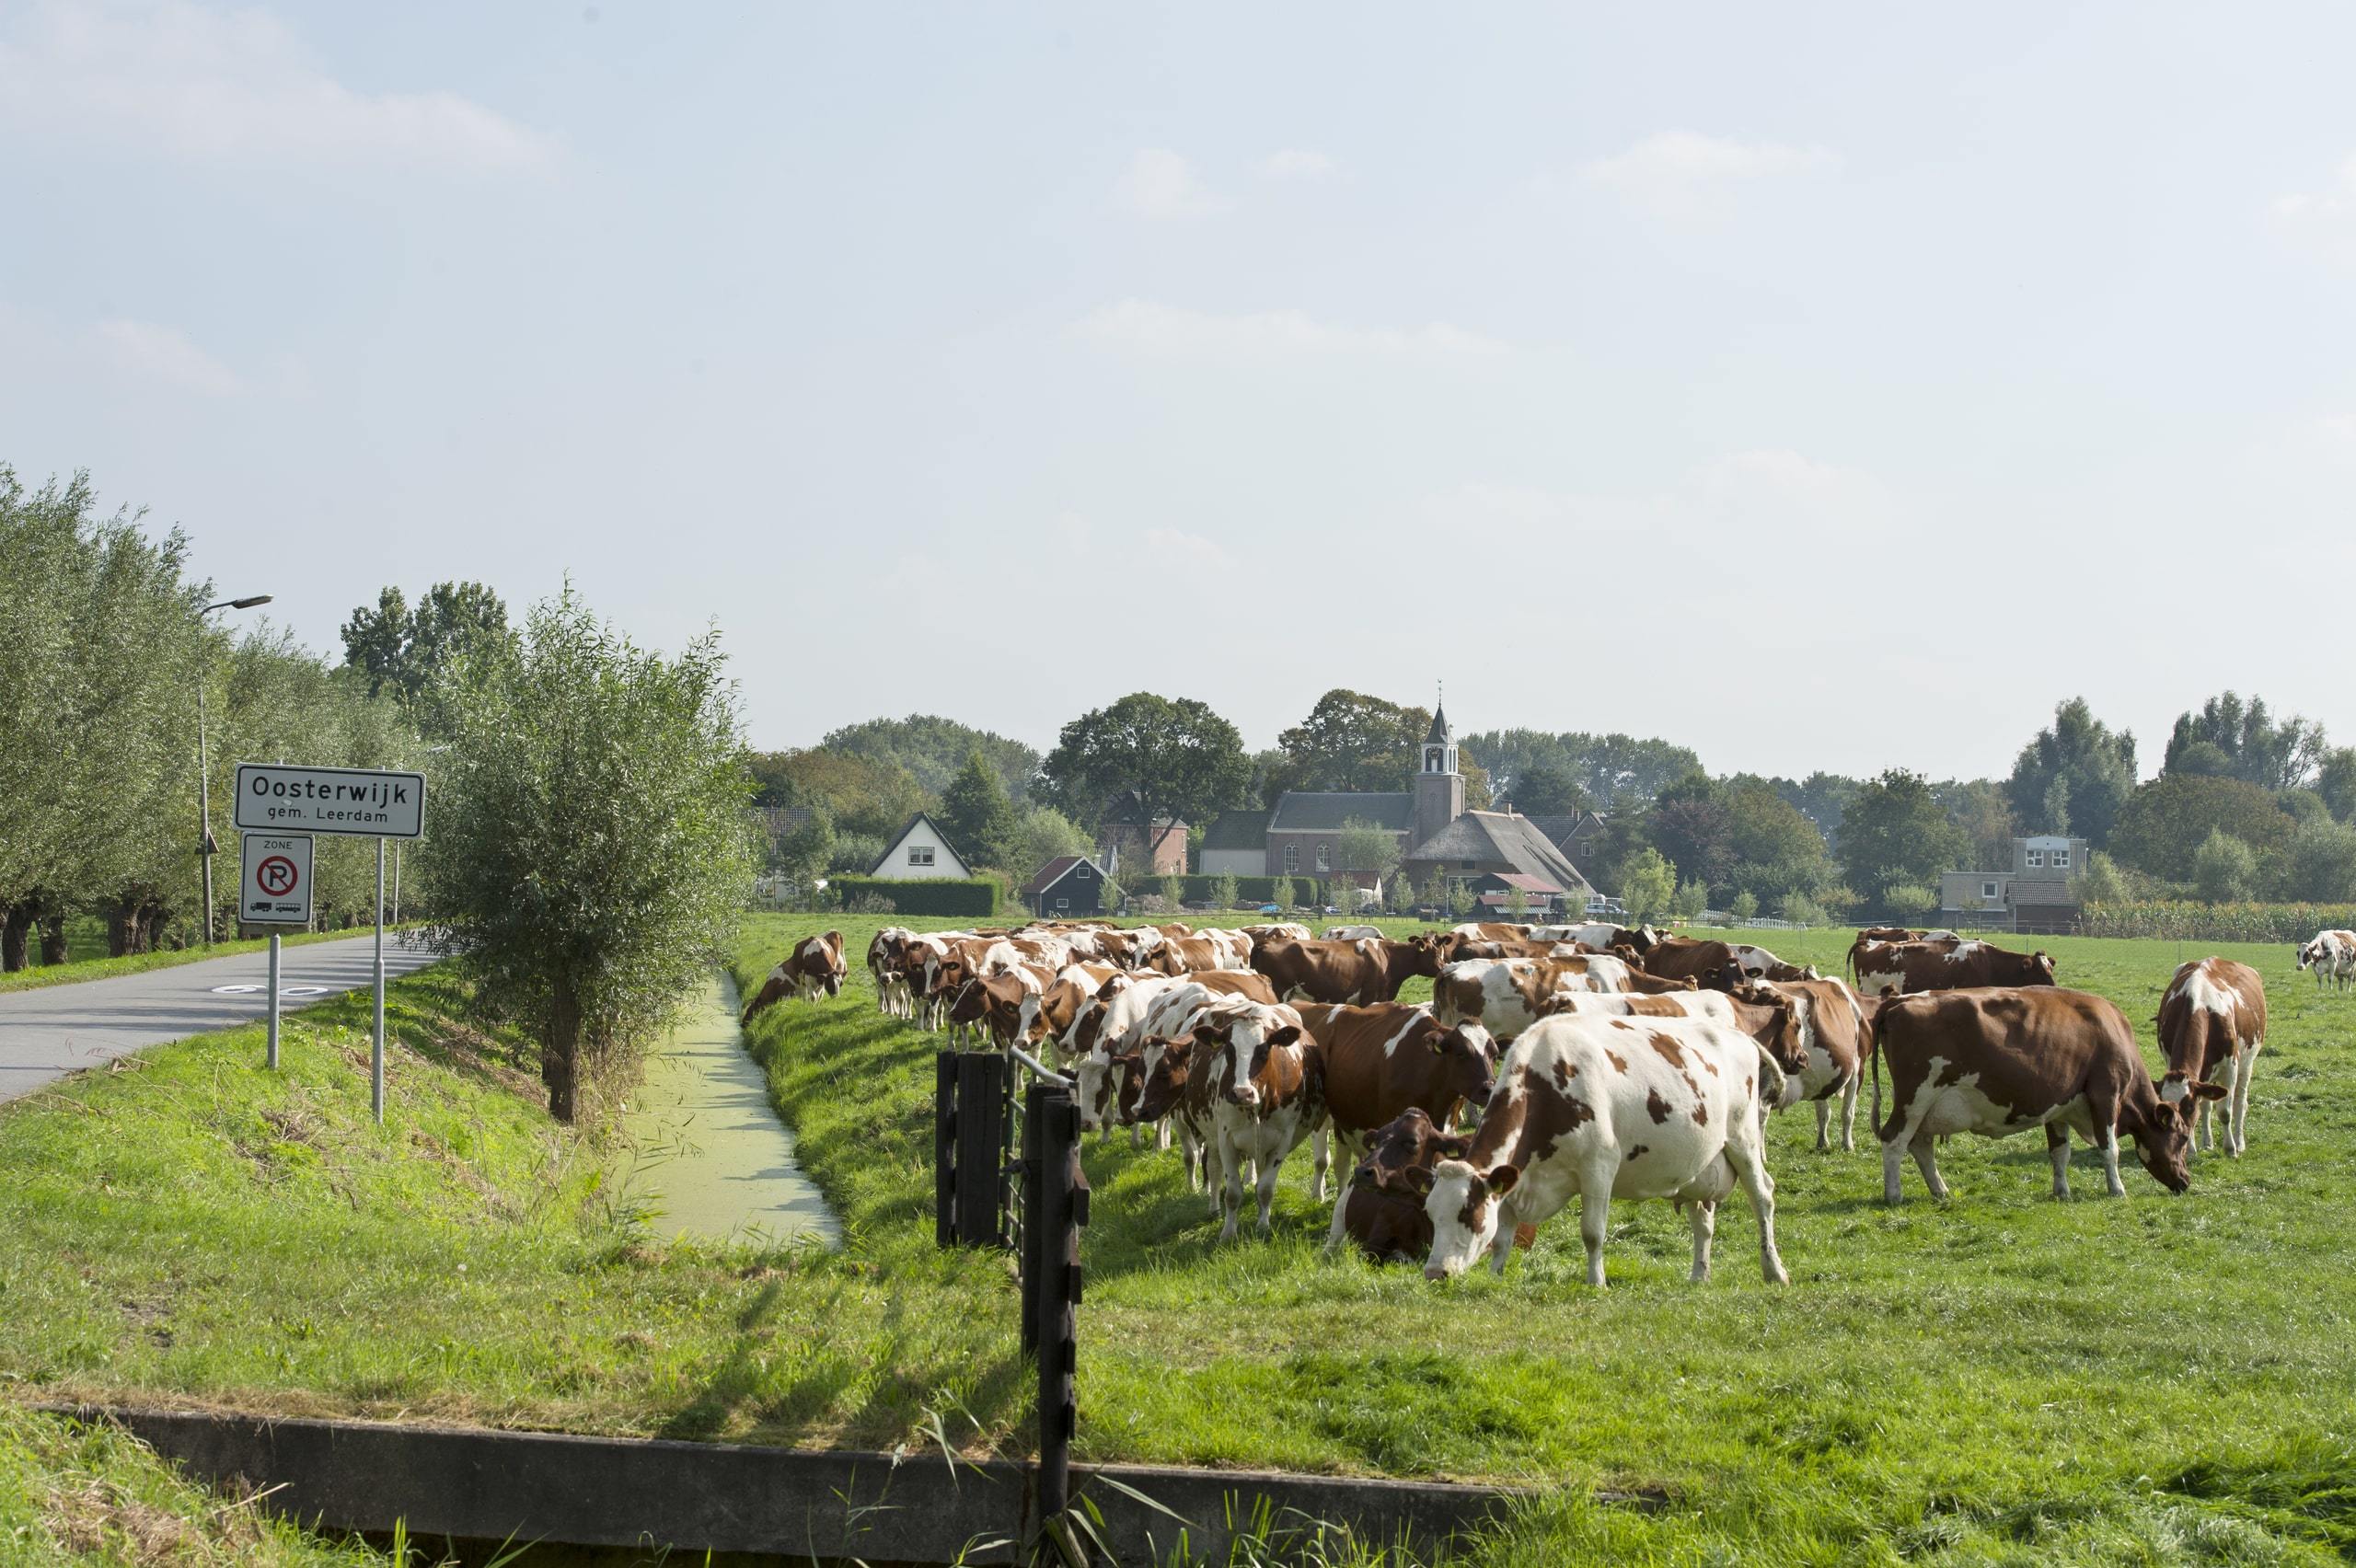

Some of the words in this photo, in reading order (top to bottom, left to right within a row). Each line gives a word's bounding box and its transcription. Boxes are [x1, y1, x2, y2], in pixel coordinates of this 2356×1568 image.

[252, 776, 408, 809] Oosterwijk
[268, 807, 307, 820] gem.
[317, 807, 388, 823] Leerdam
[263, 840, 293, 849] ZONE
